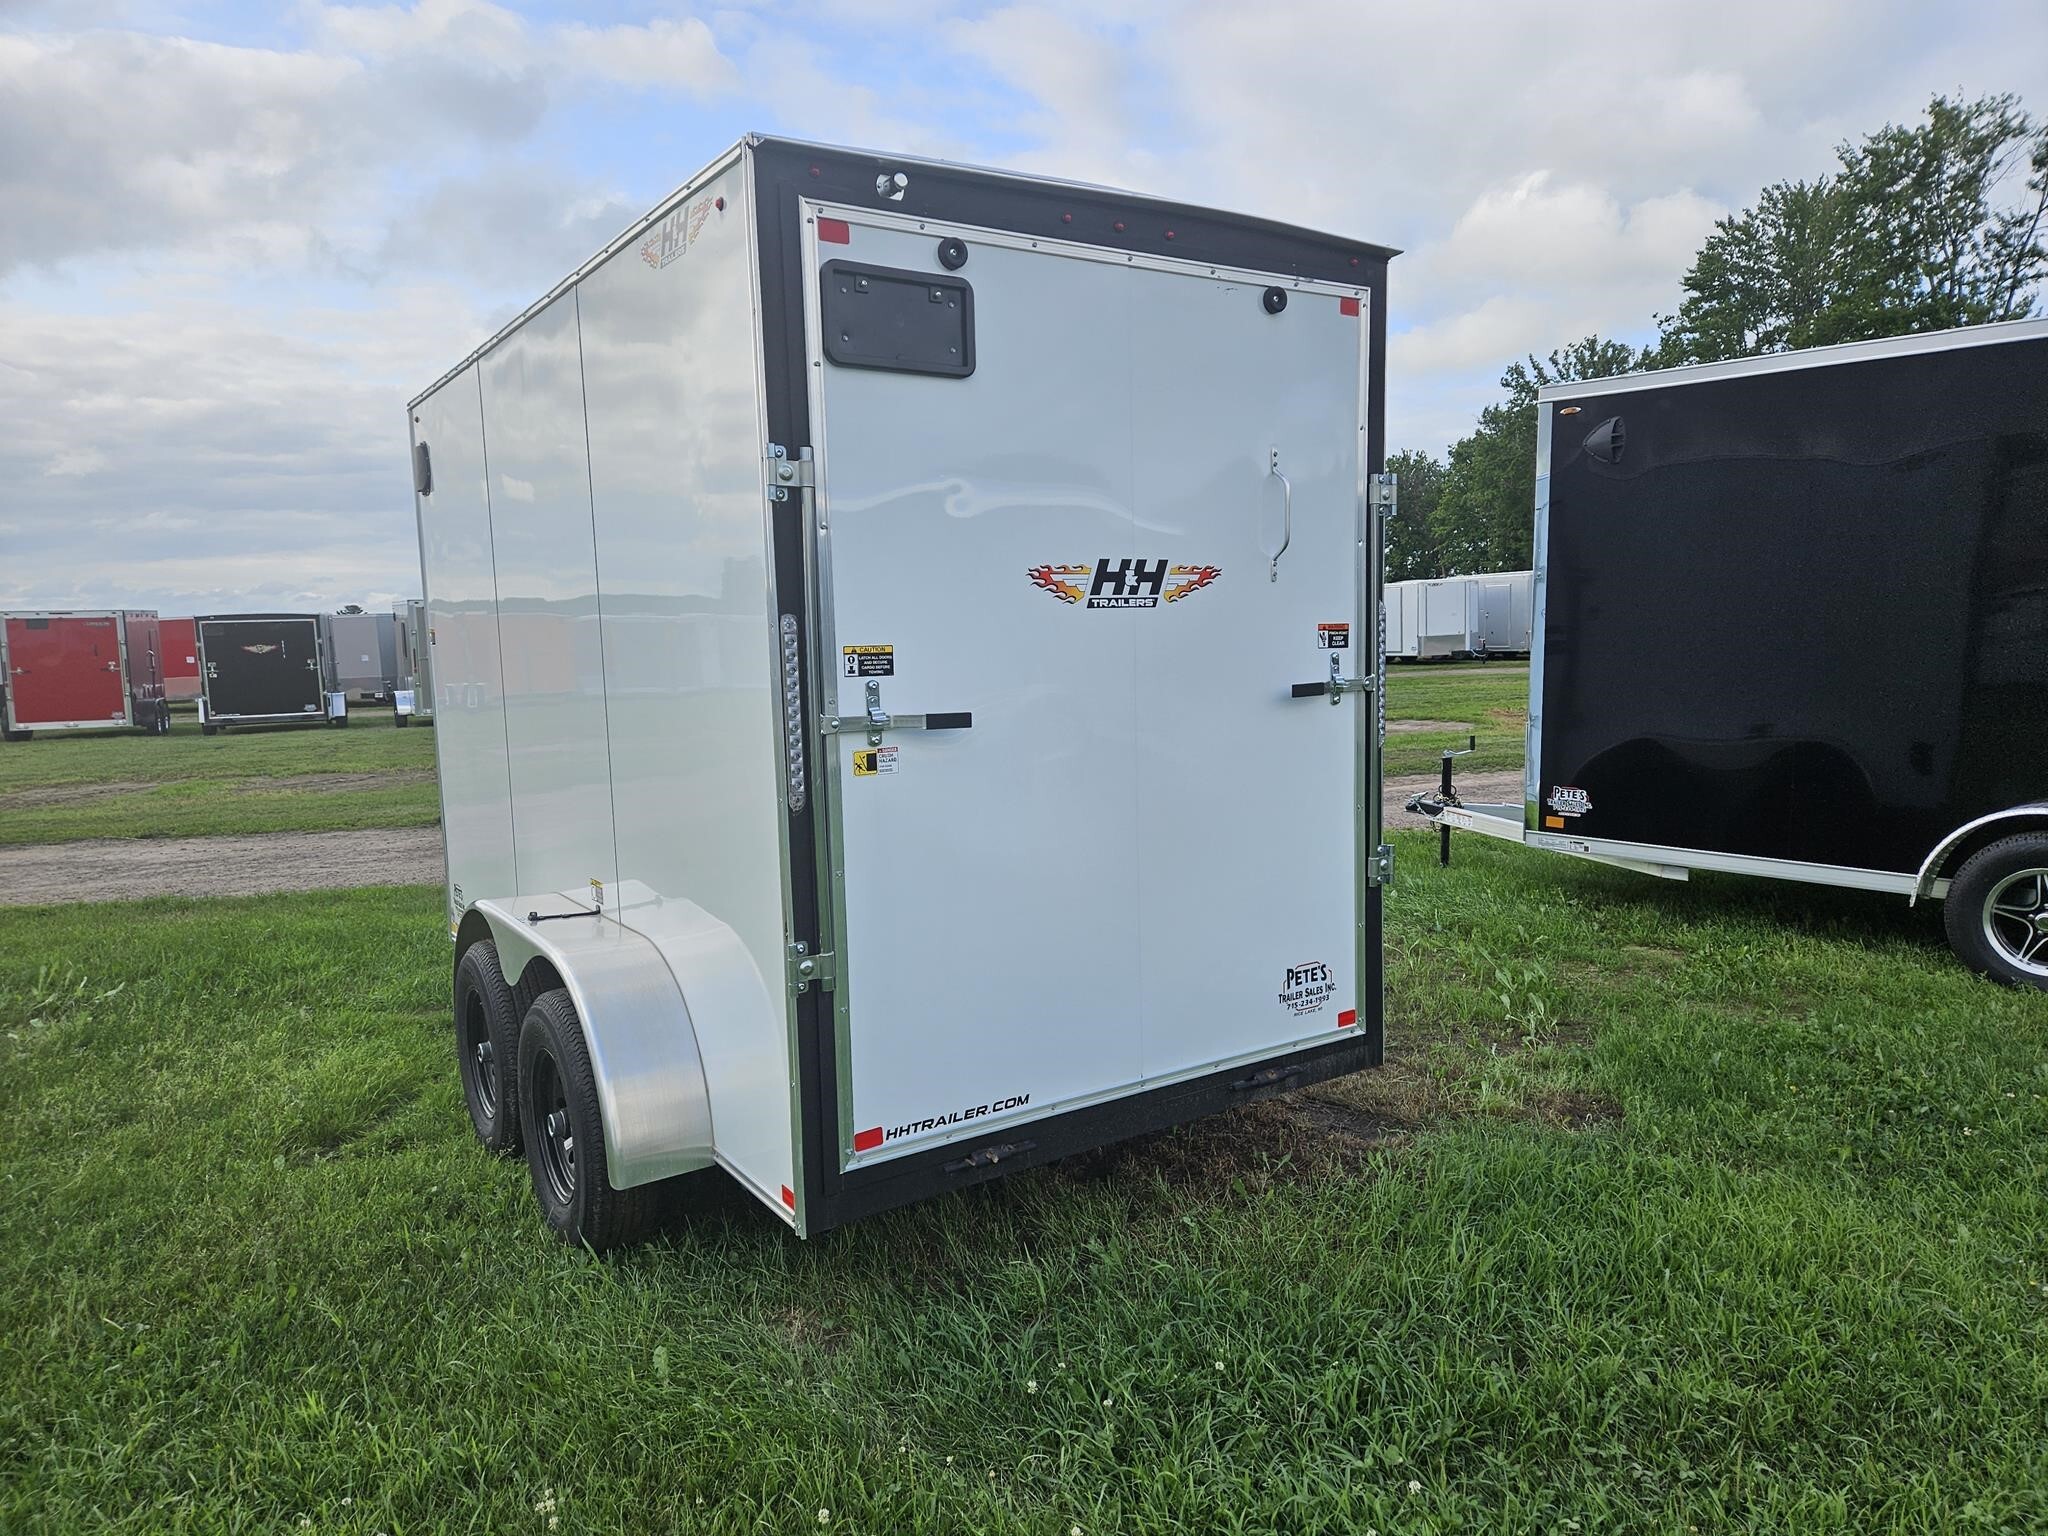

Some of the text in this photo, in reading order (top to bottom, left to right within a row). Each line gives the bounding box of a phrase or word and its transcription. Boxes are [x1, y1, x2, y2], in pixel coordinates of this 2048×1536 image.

[1089, 558, 1169, 596] H&H
[1091, 598, 1155, 608] TRAILERS
[1554, 786, 1585, 801] PETE'S
[1286, 963, 1327, 990] PETE'S
[1278, 990, 1303, 1004] TRAILER
[1304, 985, 1323, 998] SALES
[885, 1093, 1030, 1141] HHTRAILER.COM
